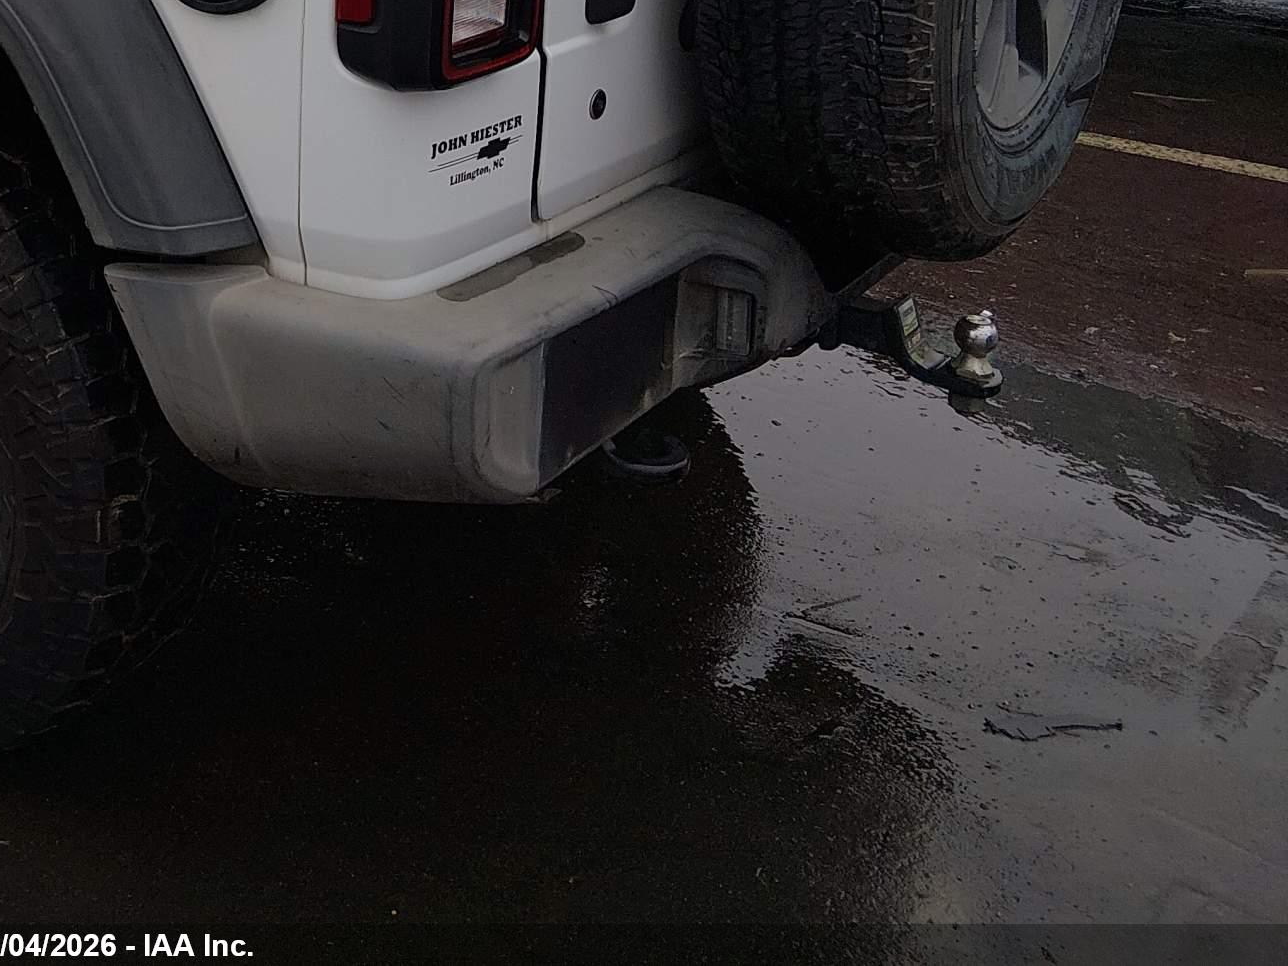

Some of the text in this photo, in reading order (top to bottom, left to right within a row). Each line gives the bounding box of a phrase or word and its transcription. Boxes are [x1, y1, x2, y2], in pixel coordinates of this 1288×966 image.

[431, 115, 523, 160] JOHN HIESTER
[449, 158, 505, 186] Lillington, NC
